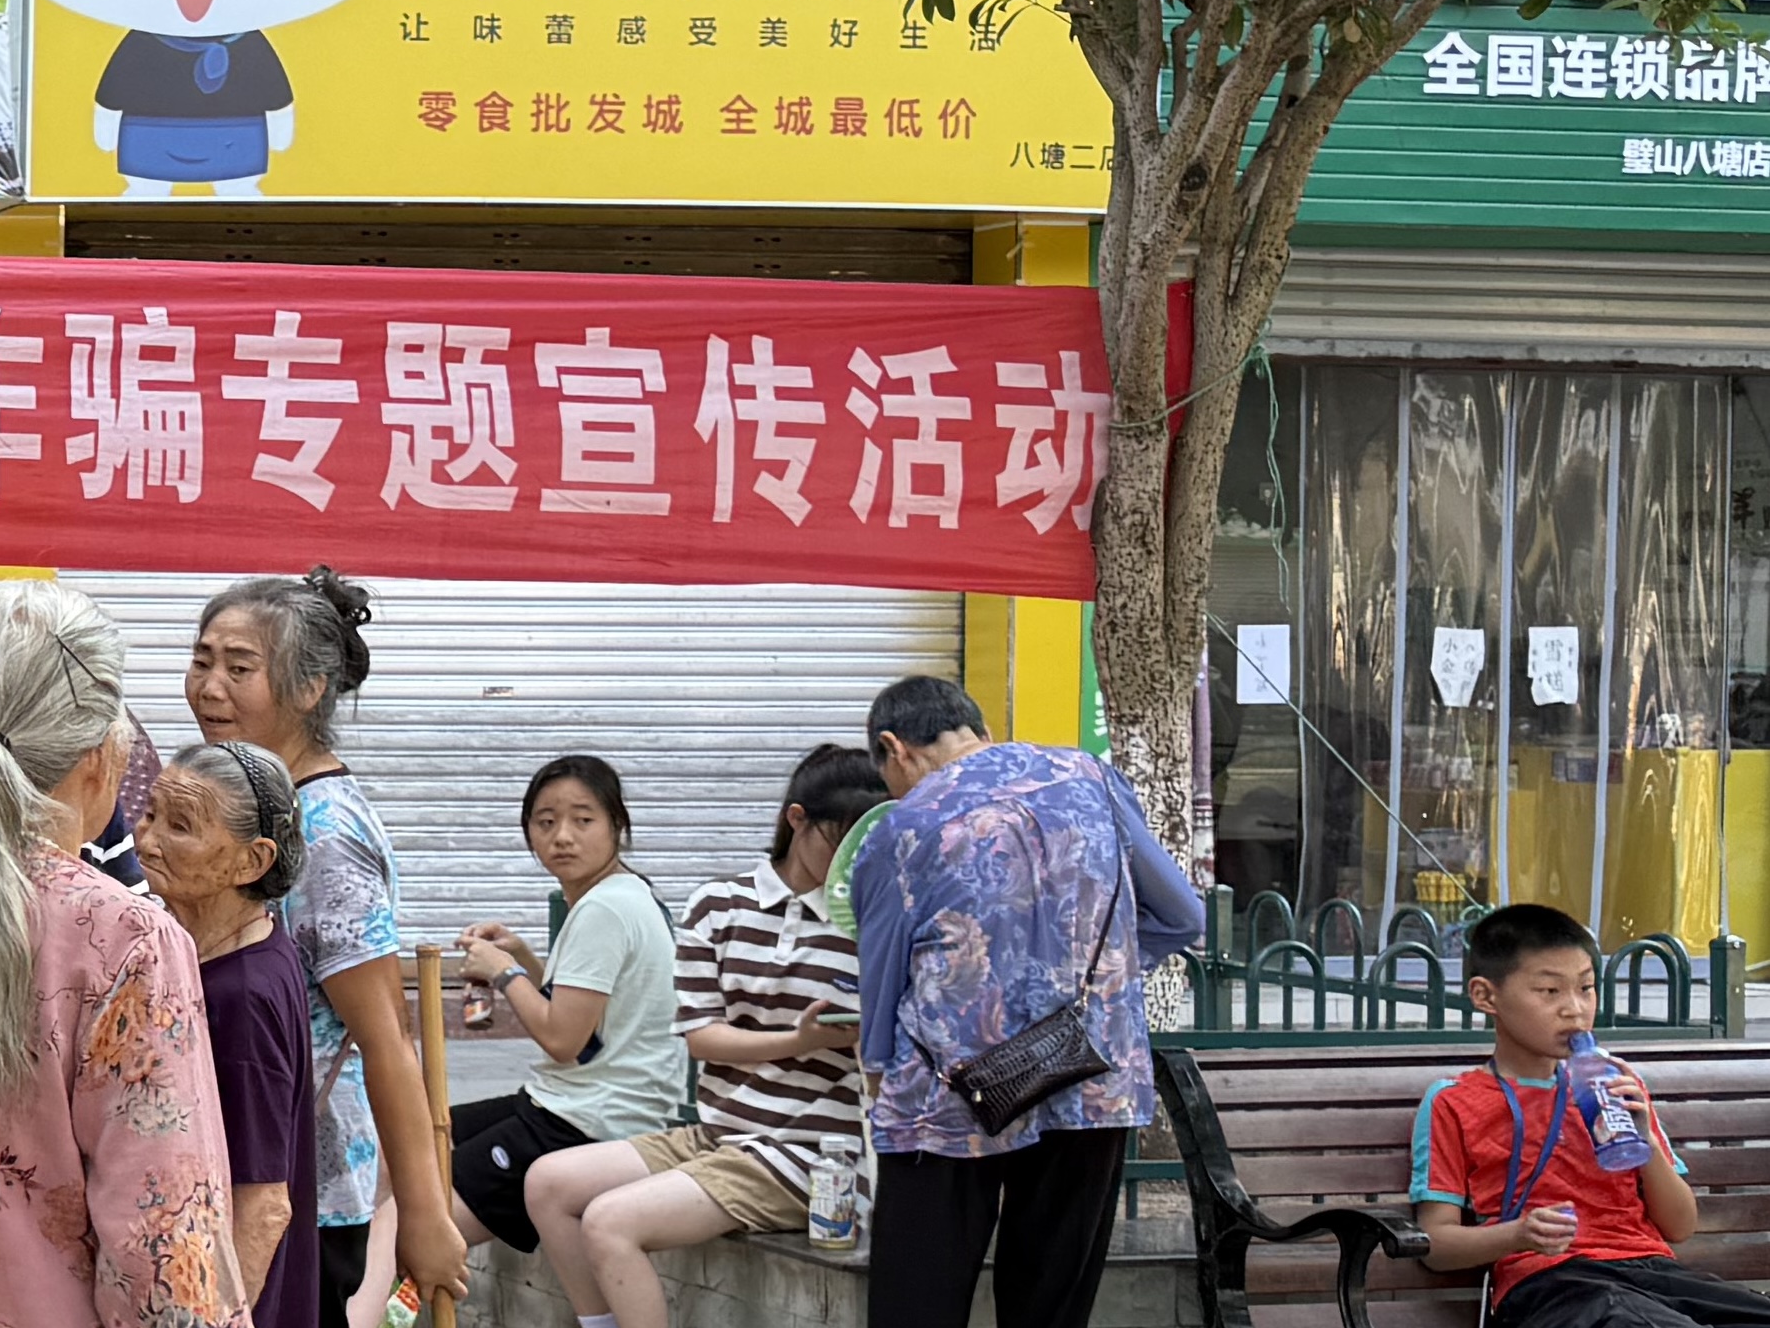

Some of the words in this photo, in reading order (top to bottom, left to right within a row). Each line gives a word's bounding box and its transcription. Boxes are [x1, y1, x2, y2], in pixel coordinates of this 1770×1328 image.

[399, 12, 999, 55] 让味蕾感受美好生活
[1422, 31, 1770, 104] 全国连锁品牌
[417, 91, 684, 136] 零食批发城
[720, 95, 979, 142] 全城最低价
